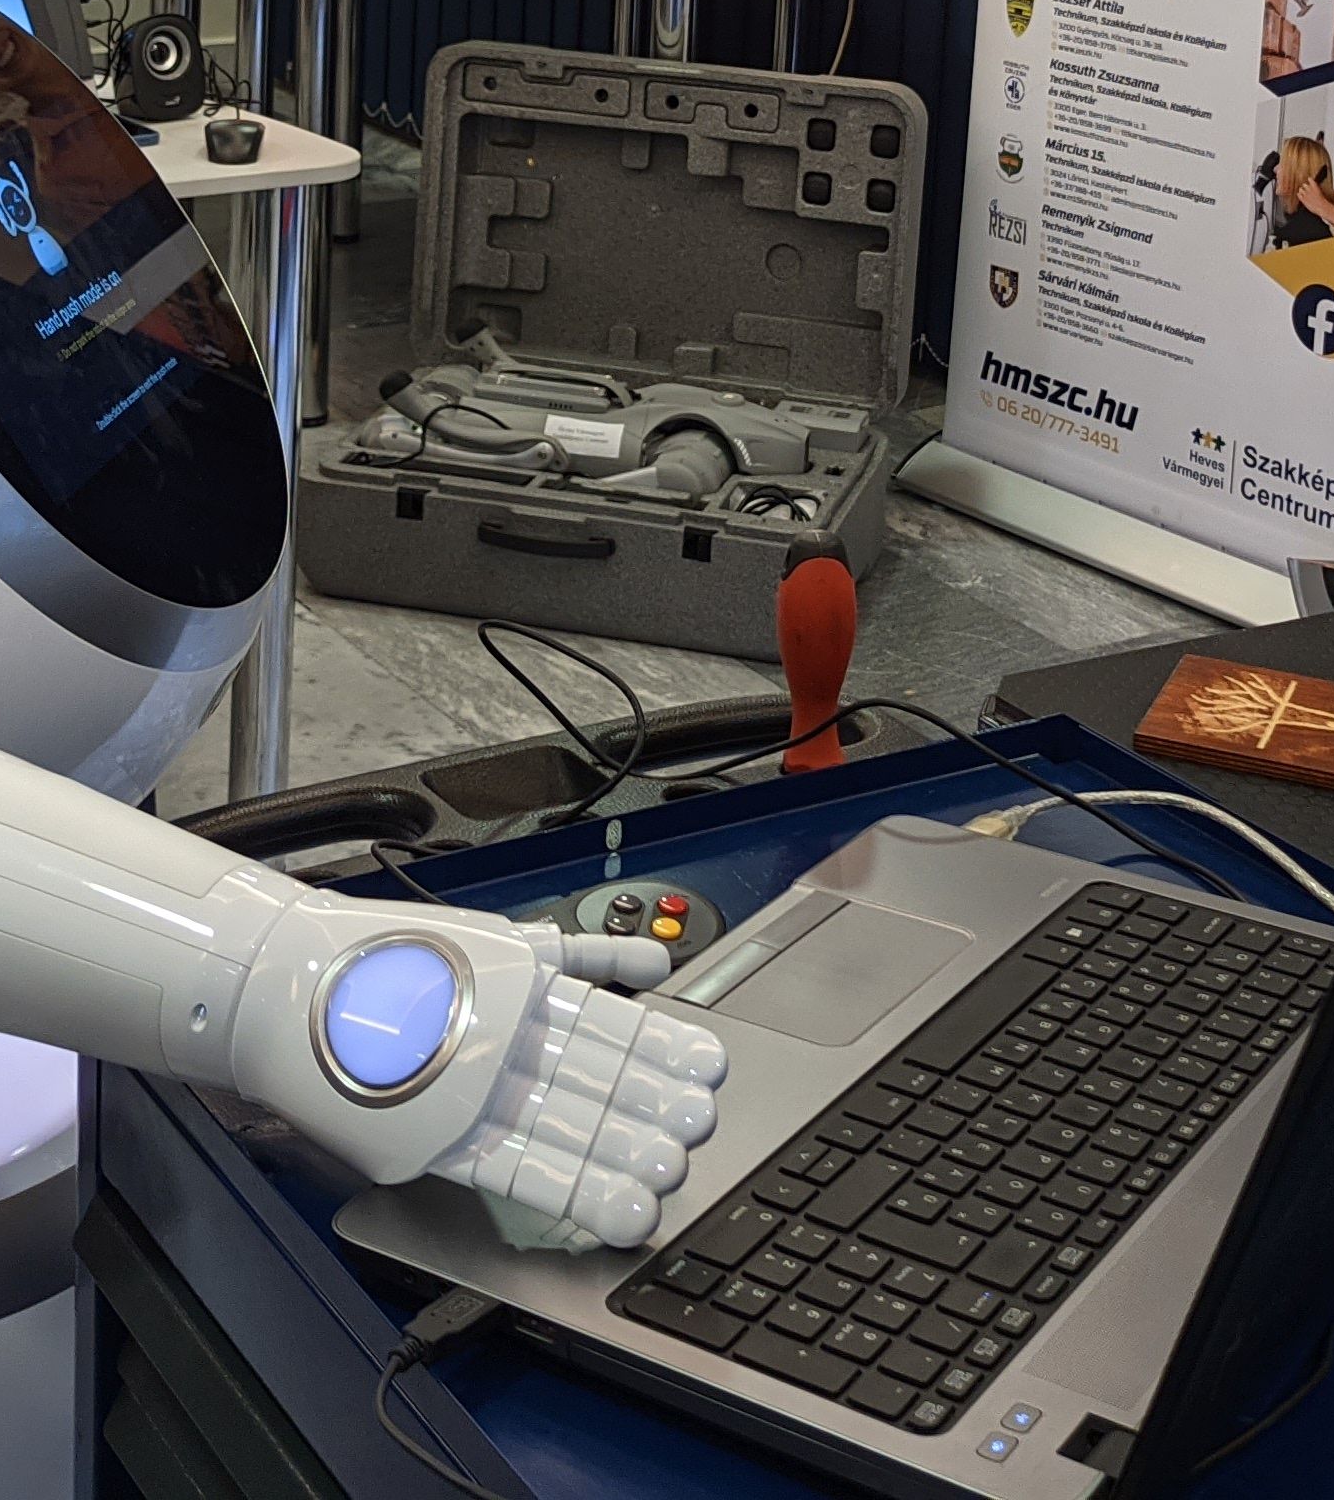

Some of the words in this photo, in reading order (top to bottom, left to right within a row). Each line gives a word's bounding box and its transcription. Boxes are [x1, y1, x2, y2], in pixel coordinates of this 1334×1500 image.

[1092, 0, 1124, 15] Attila
[1048, 87, 1057, 96] és
[1050, 58, 1096, 80] Kossuth
[1097, 69, 1160, 93] Zsuzsanna
[1045, 137, 1089, 159] Március
[1091, 149, 1107, 162] 15.
[988, 211, 1027, 245] REZSI
[1041, 204, 1096, 229] Remenyik
[1098, 218, 1153, 244] Zsigmond
[1038, 269, 1077, 291] Sárvári
[1079, 279, 1119, 303] Kálmán
[35, 308, 63, 339] Hand
[59, 296, 83, 327] push
[78, 282, 104, 309] mode
[98, 277, 111, 292] is
[108, 271, 123, 288] on
[980, 350, 1139, 432] hmszc.hu
[997, 396, 1018, 416] 06
[1021, 404, 1121, 454] 20/777-3491
[1162, 457, 1224, 490] Vármegyei
[1189, 450, 1225, 473] Heves
